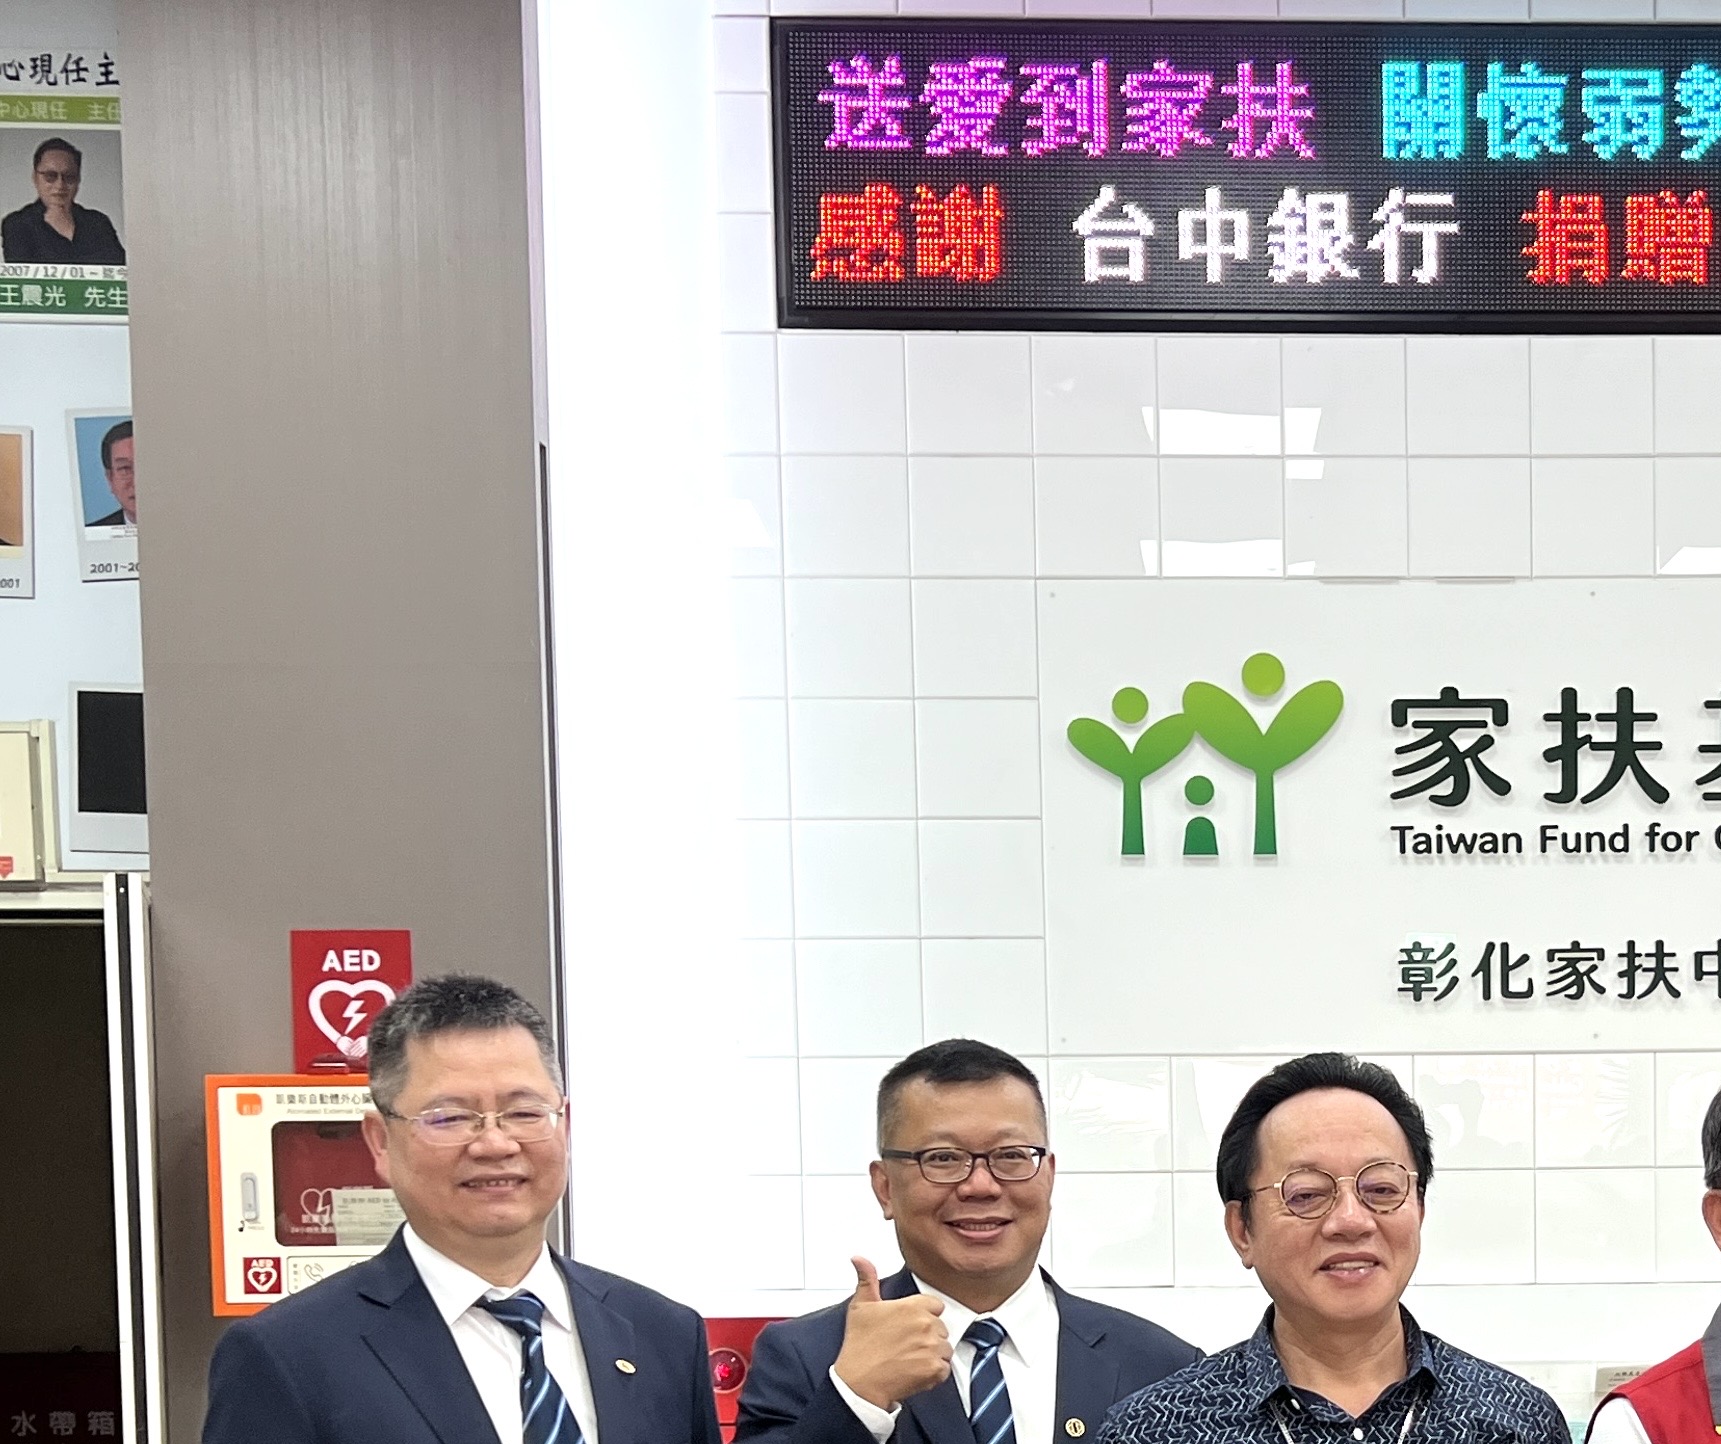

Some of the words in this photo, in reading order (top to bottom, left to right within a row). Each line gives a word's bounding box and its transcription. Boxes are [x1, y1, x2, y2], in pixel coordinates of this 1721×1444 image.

[816, 53, 1316, 160] 送愛到家扶
[810, 183, 1002, 284] 感謝
[1073, 186, 1460, 285] 台中銀行
[84, 286, 128, 308] 先生
[1390, 824, 1523, 855] Taiwan
[1539, 824, 1630, 854] Fund
[1645, 822, 1699, 853] for
[322, 949, 381, 972] AED
[251, 1259, 274, 1268] AED
